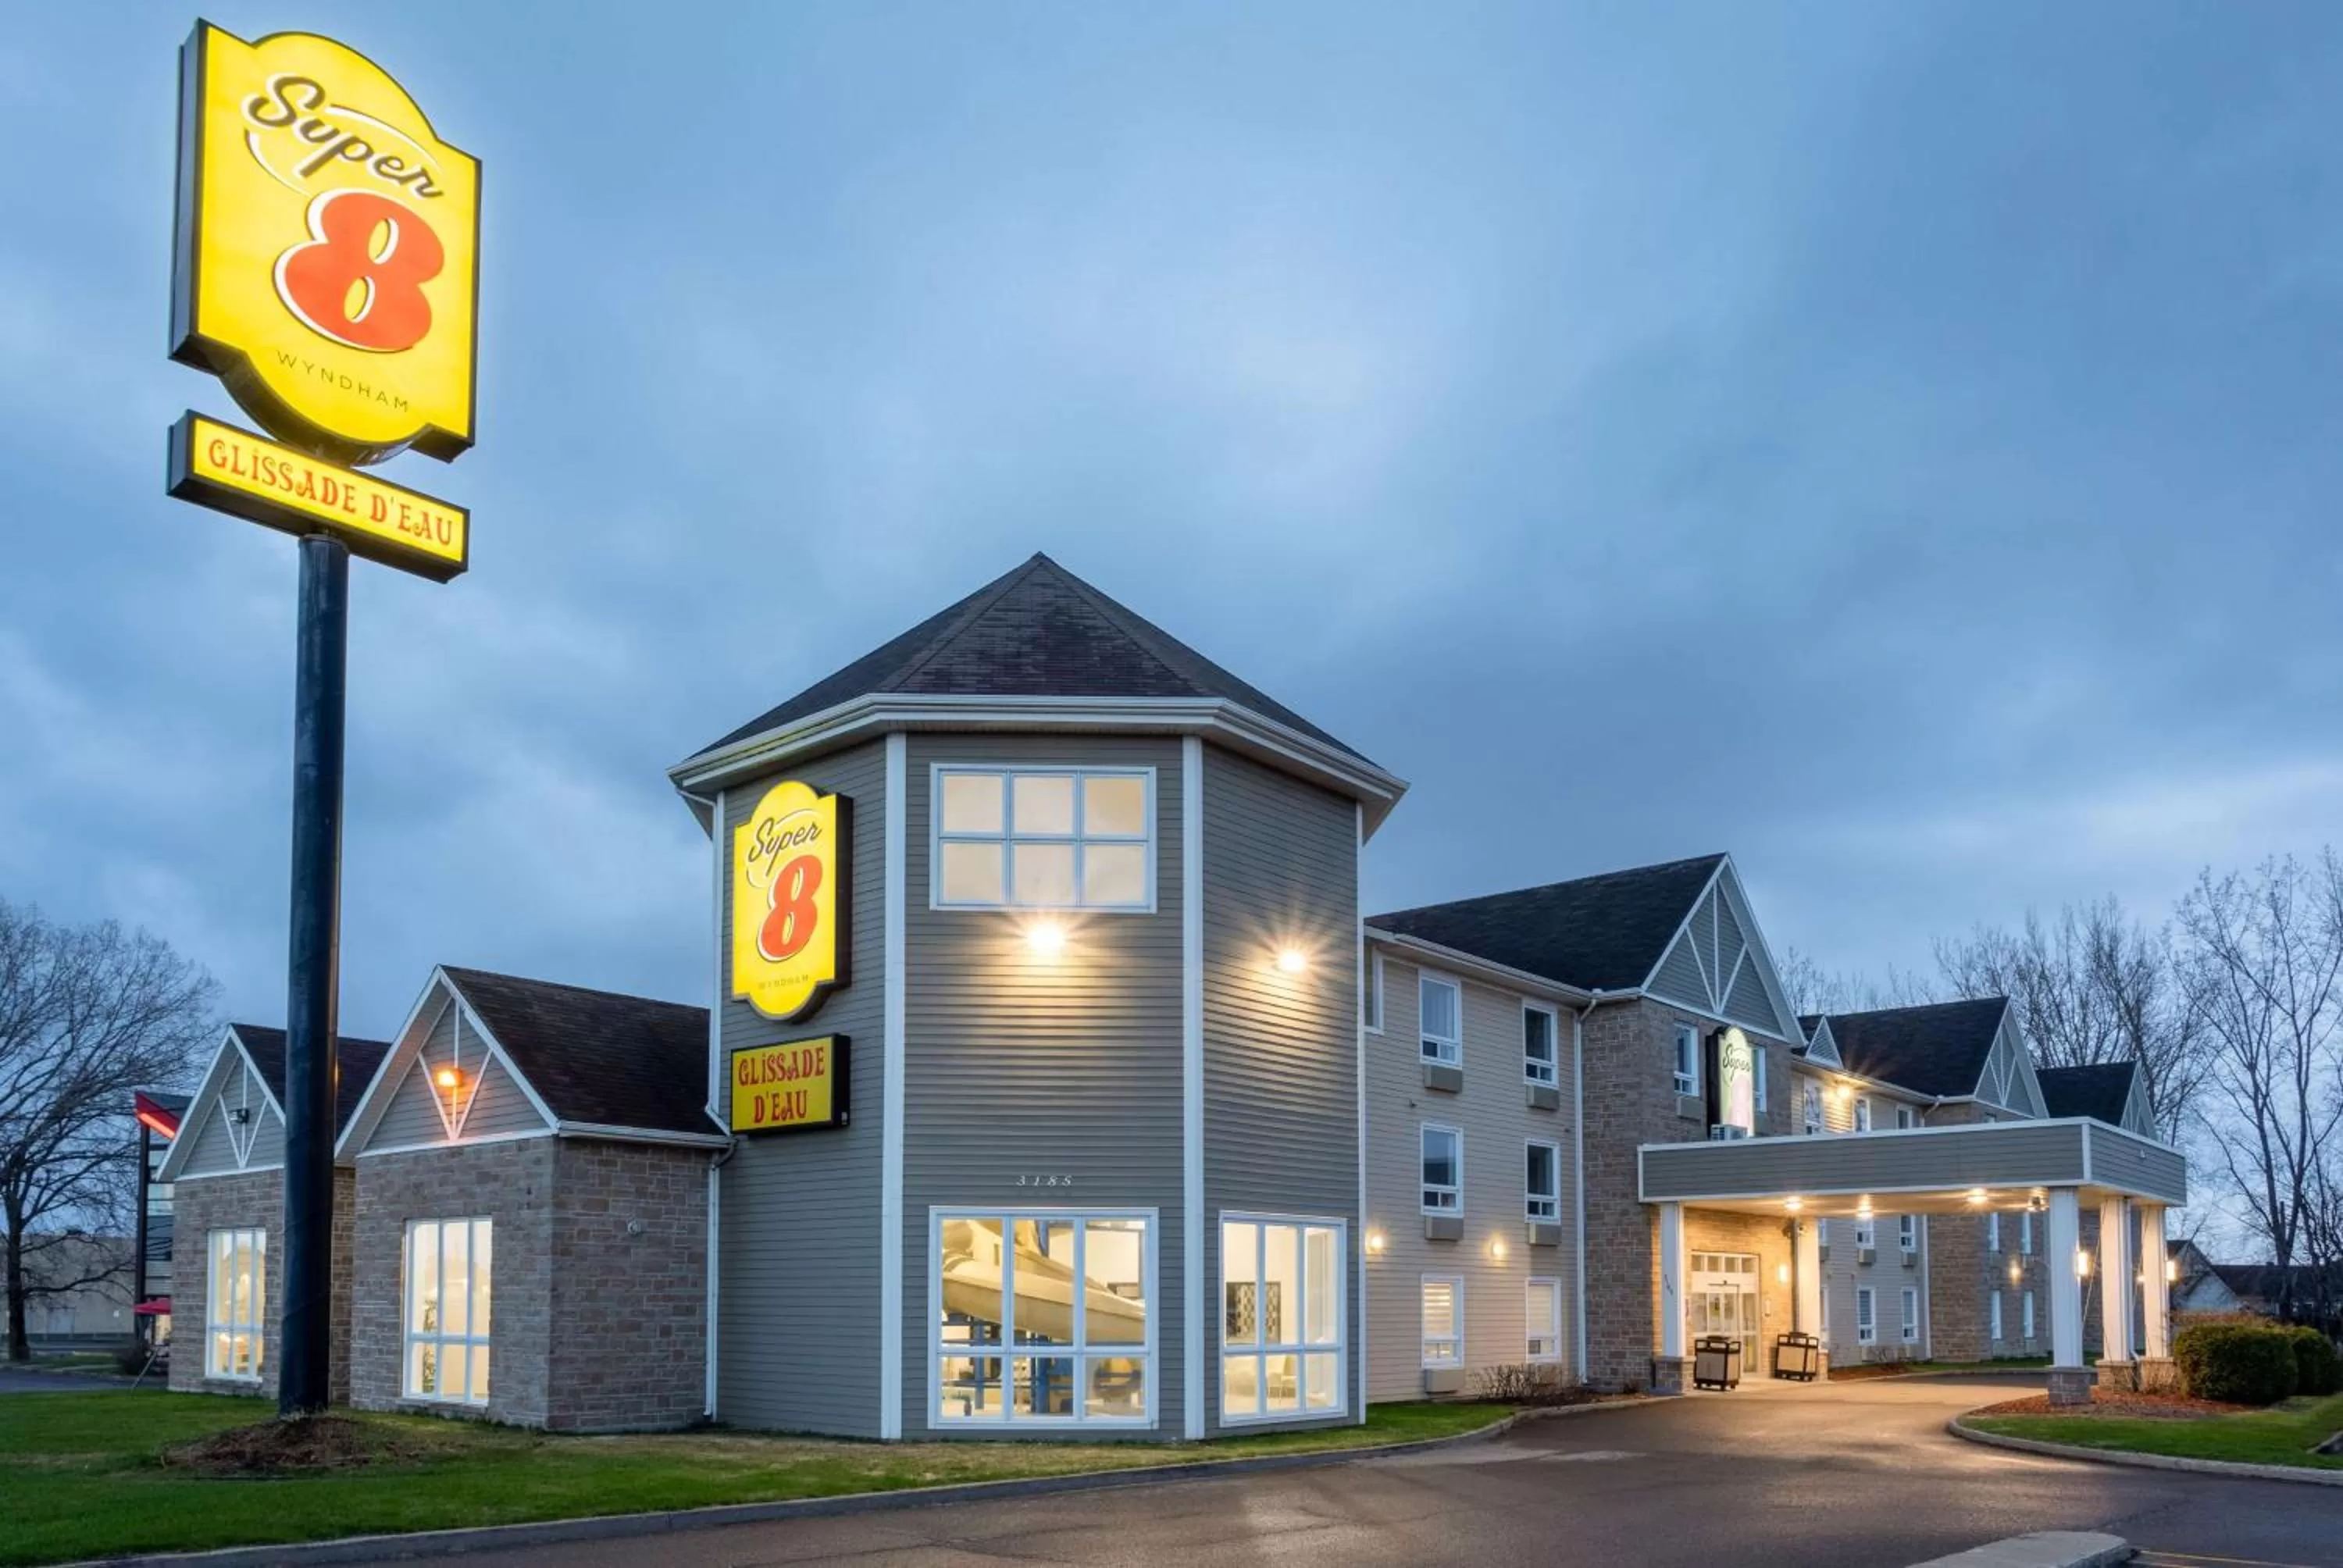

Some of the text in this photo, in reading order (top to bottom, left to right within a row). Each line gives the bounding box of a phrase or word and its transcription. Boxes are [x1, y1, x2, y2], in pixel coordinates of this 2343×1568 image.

[241, 74, 444, 199] Super
[272, 188, 444, 354] 8
[277, 350, 408, 412] WYNDHAM
[370, 492, 453, 546] D'EAU
[747, 818, 822, 878] Super
[756, 853, 822, 962] 8
[754, 1089, 808, 1124] D'EAU
[1016, 1174, 1072, 1187] 3185
